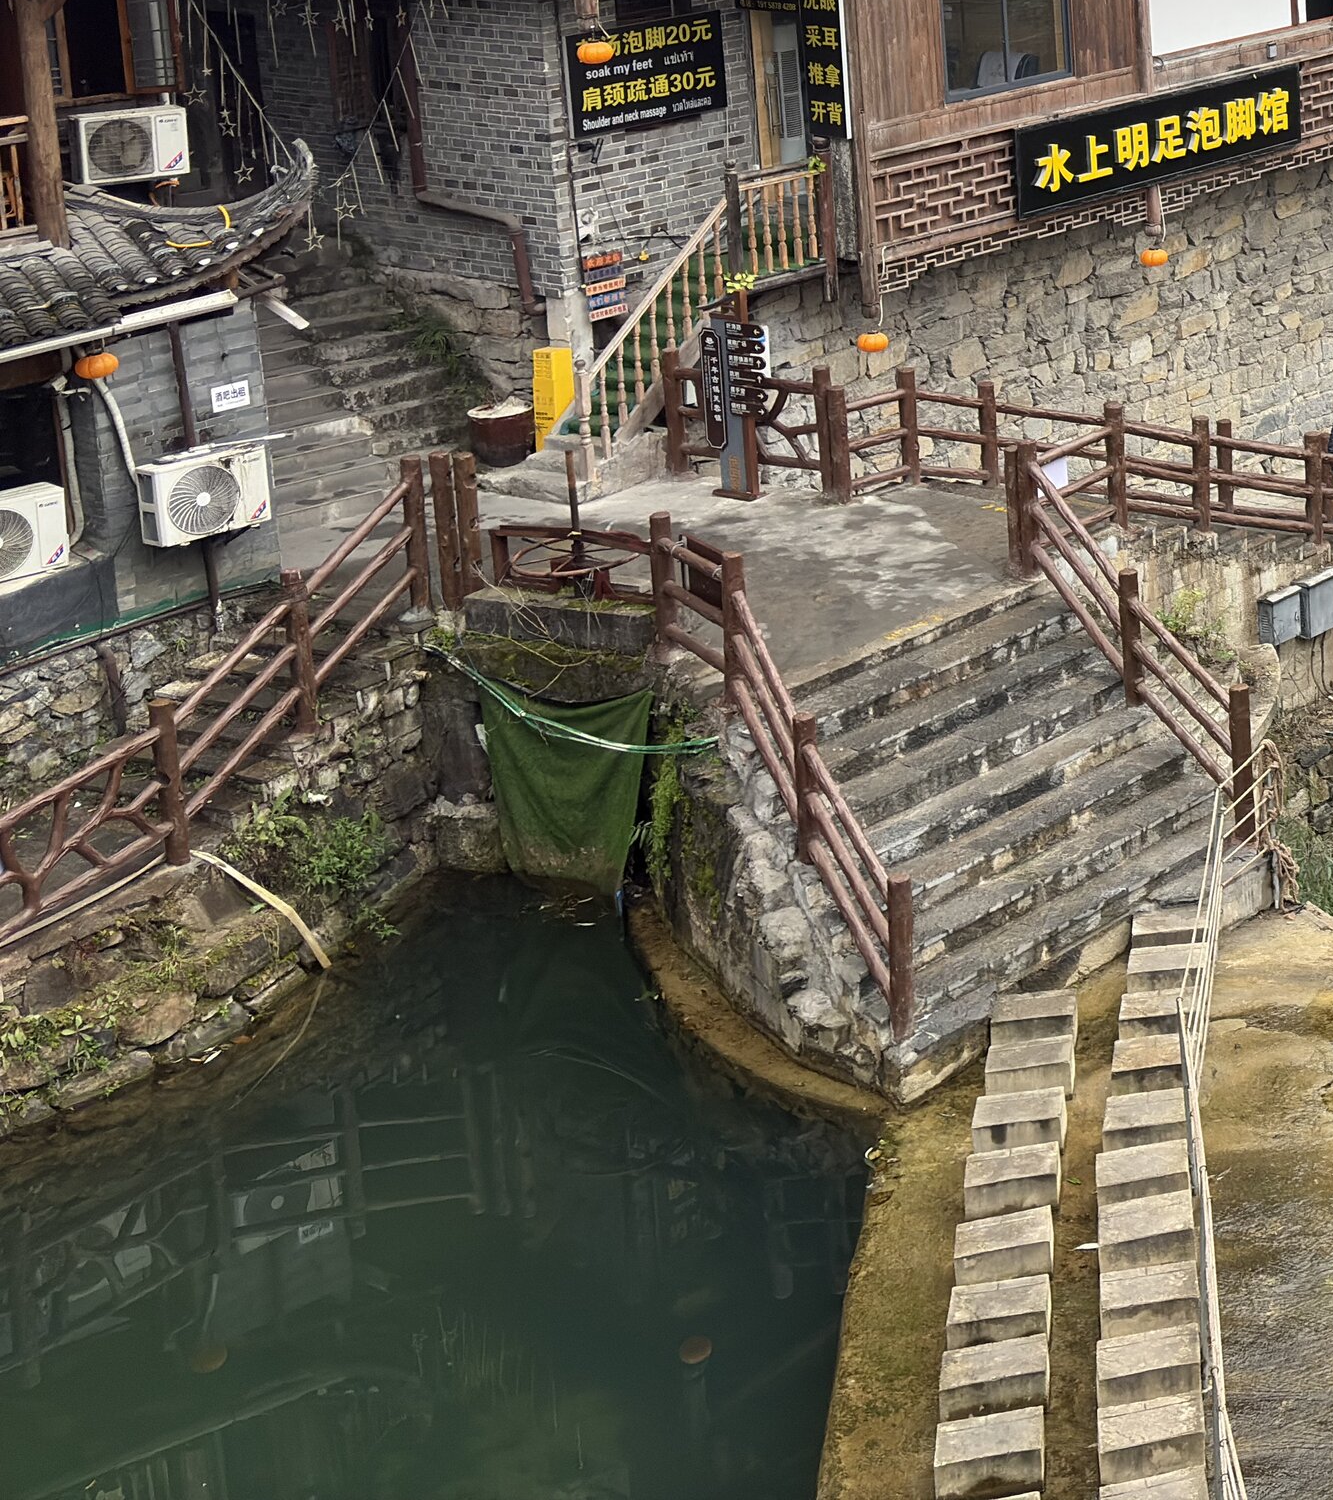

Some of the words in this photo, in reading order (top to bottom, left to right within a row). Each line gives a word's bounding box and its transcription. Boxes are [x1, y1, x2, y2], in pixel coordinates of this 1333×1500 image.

[575, 19, 713, 61] 汤泡脚20元
[805, 25, 839, 50] 采耳
[585, 67, 611, 81] soak
[613, 63, 630, 76] my
[632, 57, 654, 72] feet
[808, 61, 841, 88] 推拿
[581, 65, 717, 112] 肩颈疏通30元
[582, 114, 611, 132] Shoulder
[611, 111, 624, 125] and
[624, 108, 640, 123] neck
[640, 104, 667, 121] massage
[811, 100, 843, 126] 开背
[1031, 86, 1290, 194] 水上明足泡脚馆
